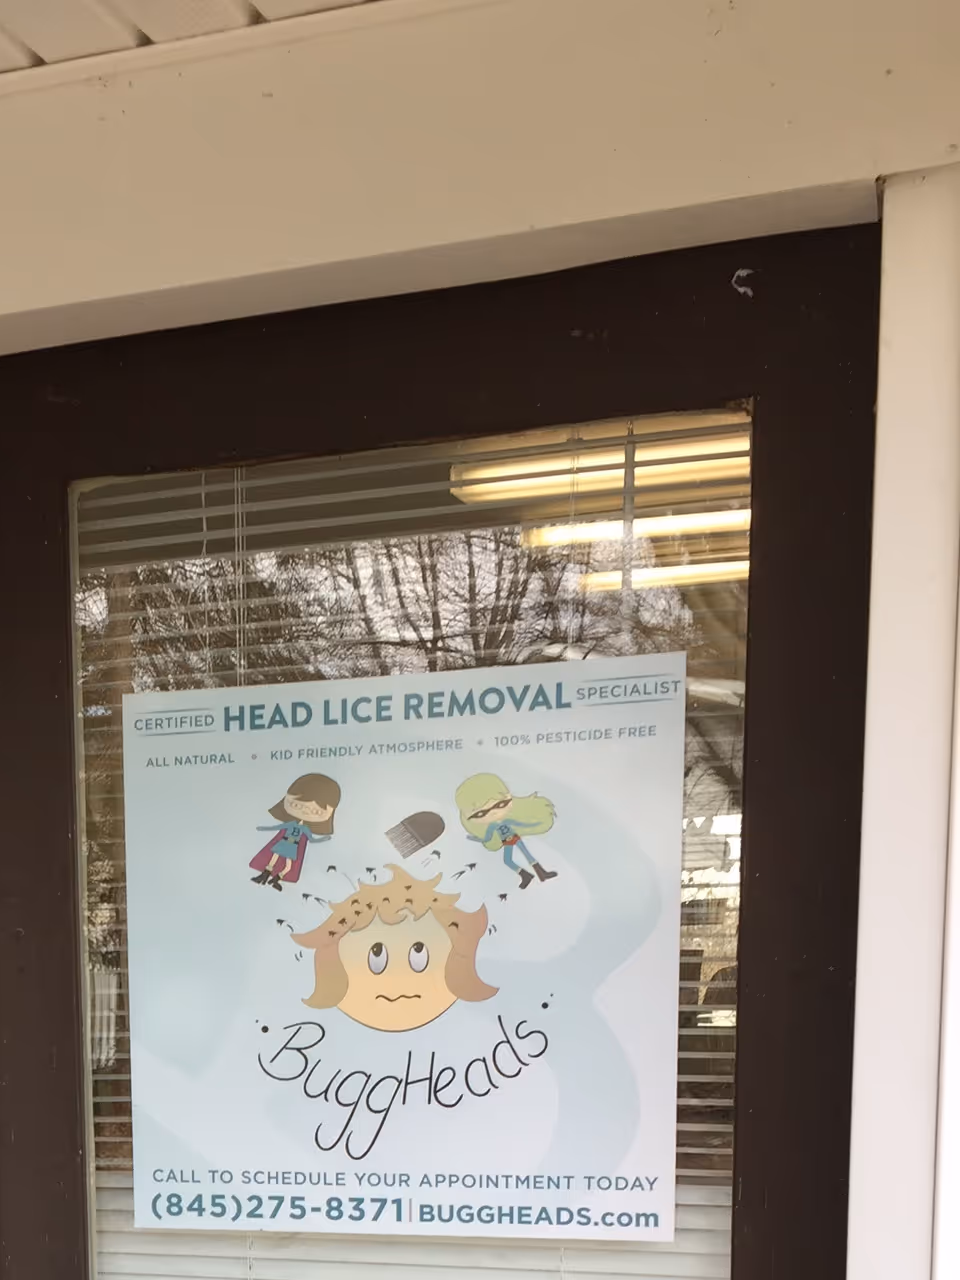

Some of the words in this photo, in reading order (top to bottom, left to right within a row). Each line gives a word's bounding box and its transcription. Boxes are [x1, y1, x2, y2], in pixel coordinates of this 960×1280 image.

[576, 679, 682, 701] SPECIALIST
[223, 701, 313, 732] HEAD
[323, 695, 393, 726] LICE
[403, 682, 572, 720] REMOVAL
[134, 714, 215, 732] CERTIFIED
[493, 735, 531, 748] 100%
[536, 727, 613, 744] PESTICIDE
[618, 724, 657, 739] FREE
[145, 756, 170, 768] ALL
[174, 752, 235, 766] NATURAL
[270, 749, 293, 761] KID
[297, 744, 364, 759] FRIENDLY
[368, 738, 463, 755] ATMOSPHERE
[257, 1014, 551, 1162] BuggHeads
[152, 1168, 201, 1184] CALL
[208, 1169, 234, 1184] TO
[241, 1170, 346, 1187] SCHEDULE
[354, 1172, 411, 1187] YOUR
[419, 1173, 574, 1190] APPOINTMENT
[583, 1175, 659, 1191] TODAY
[151, 1192, 403, 1222] (845)275-8371
[418, 1203, 660, 1228] BUGGHEADS.com
